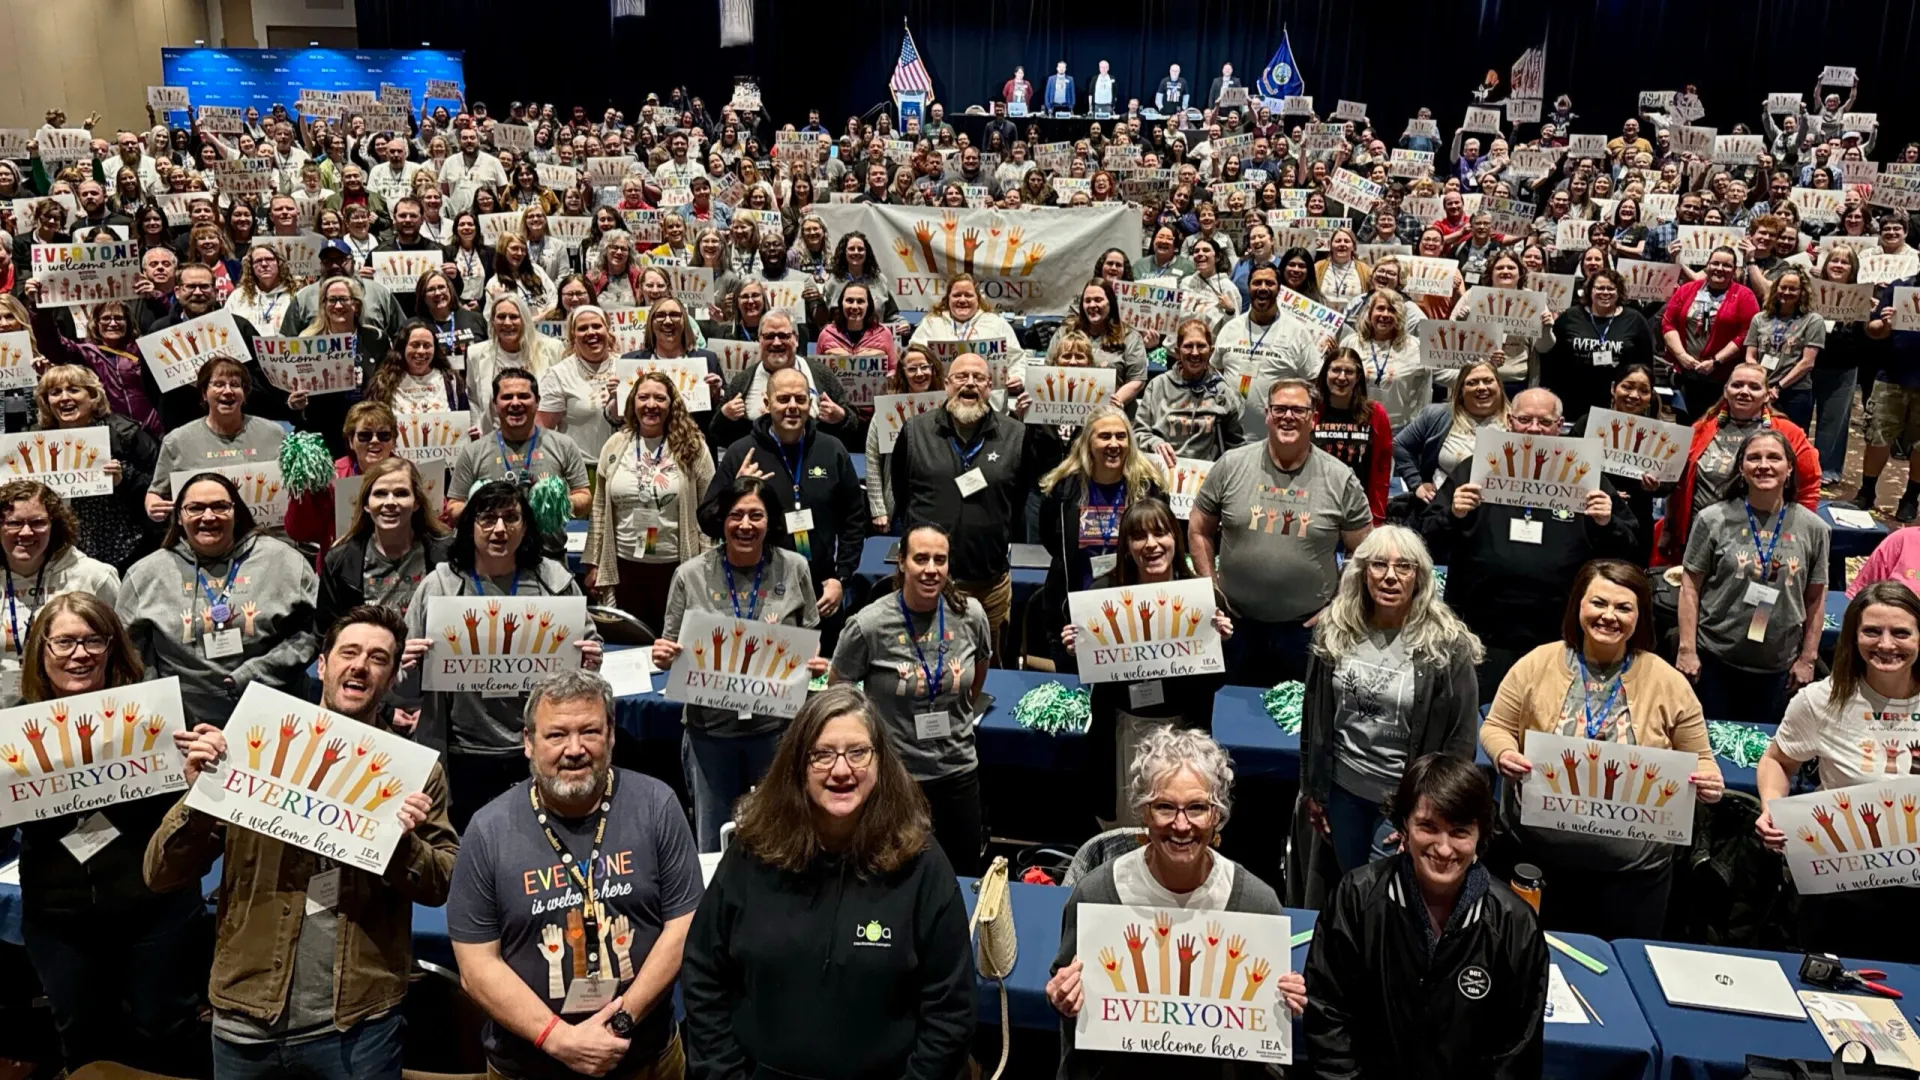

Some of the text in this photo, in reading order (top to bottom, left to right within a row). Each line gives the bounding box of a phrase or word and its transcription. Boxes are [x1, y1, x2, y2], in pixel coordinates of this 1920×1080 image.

[33, 243, 138, 263] EVERYONE
[34, 255, 139, 272] is welcome here
[1113, 282, 1183, 303] EVERYONE
[1122, 293, 1181, 310] welcome here
[1281, 302, 1338, 334] welcome here
[255, 337, 351, 355] EVERYONE
[270, 350, 321, 363] welcome
[325, 349, 354, 361] here
[867, 365, 888, 378] here
[1315, 431, 1348, 440] WELCOME
[1494, 495, 1571, 510] is welcome here
[1094, 640, 1206, 665] EVERYONE
[1202, 658, 1218, 666] IEA
[443, 657, 565, 675] EVERYONE
[1110, 662, 1195, 680] is welcome here
[456, 681, 465, 691] is
[471, 677, 519, 691] welcome
[687, 670, 792, 700] EVERYONE
[695, 693, 775, 715] is welcome here
[9, 751, 169, 803] EVERYONE
[164, 773, 184, 784] IEA
[35, 809, 48, 819] is
[54, 793, 116, 815] welcome
[121, 783, 154, 799] here
[223, 769, 379, 842] EVERYONE
[1541, 795, 1673, 826] EVERYONE
[230, 809, 348, 858] is welcome here
[1556, 820, 1657, 842] is welcome here
[1667, 830, 1684, 839] IEA
[360, 847, 380, 861] IEA
[1811, 847, 1920, 876] EVERYO
[1836, 874, 1909, 891] is welcome
[531, 880, 633, 914] is welcoe here
[1101, 998, 1268, 1032] EVERYONE
[1122, 1031, 1248, 1059] is welcome here
[1261, 1040, 1281, 1051] IEA
